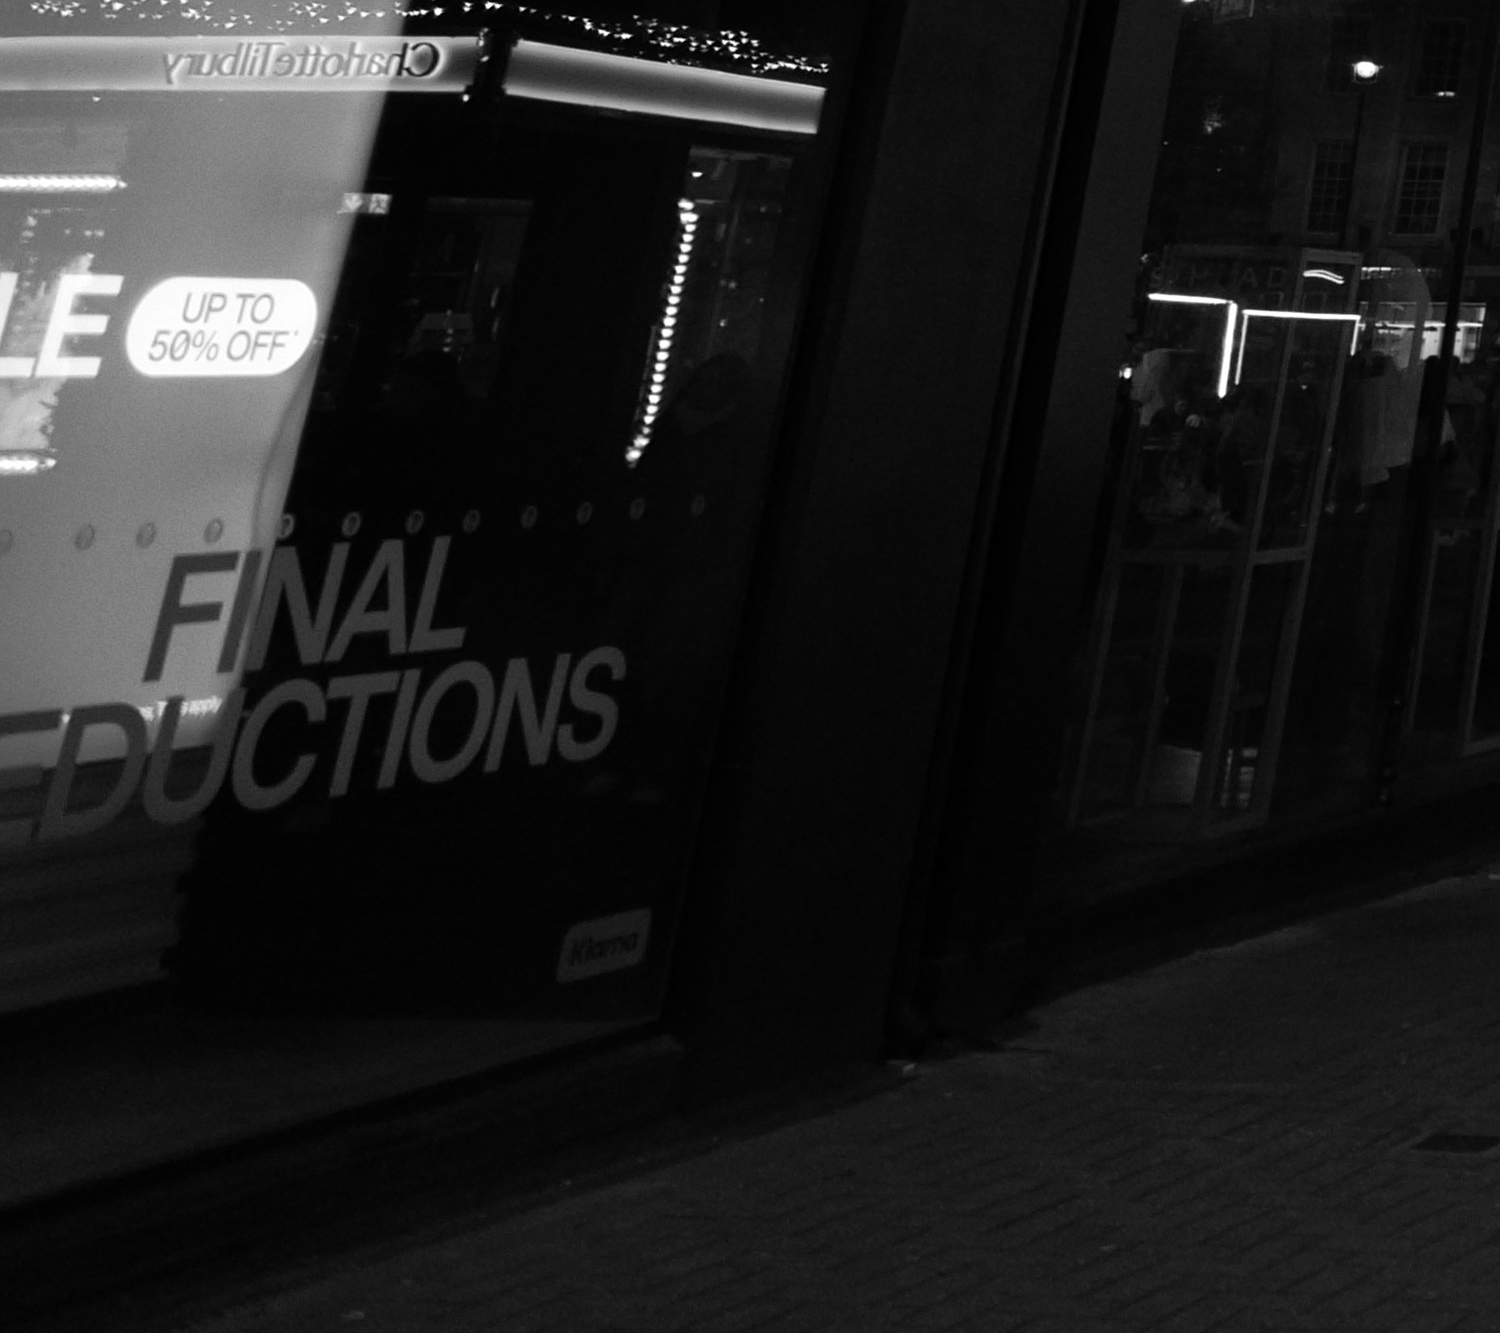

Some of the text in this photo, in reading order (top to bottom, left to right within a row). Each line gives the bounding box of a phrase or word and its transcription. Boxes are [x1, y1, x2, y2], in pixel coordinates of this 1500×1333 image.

[181, 291, 275, 325] UP TO
[148, 329, 219, 362] 50%
[142, 535, 468, 683] FINAL
